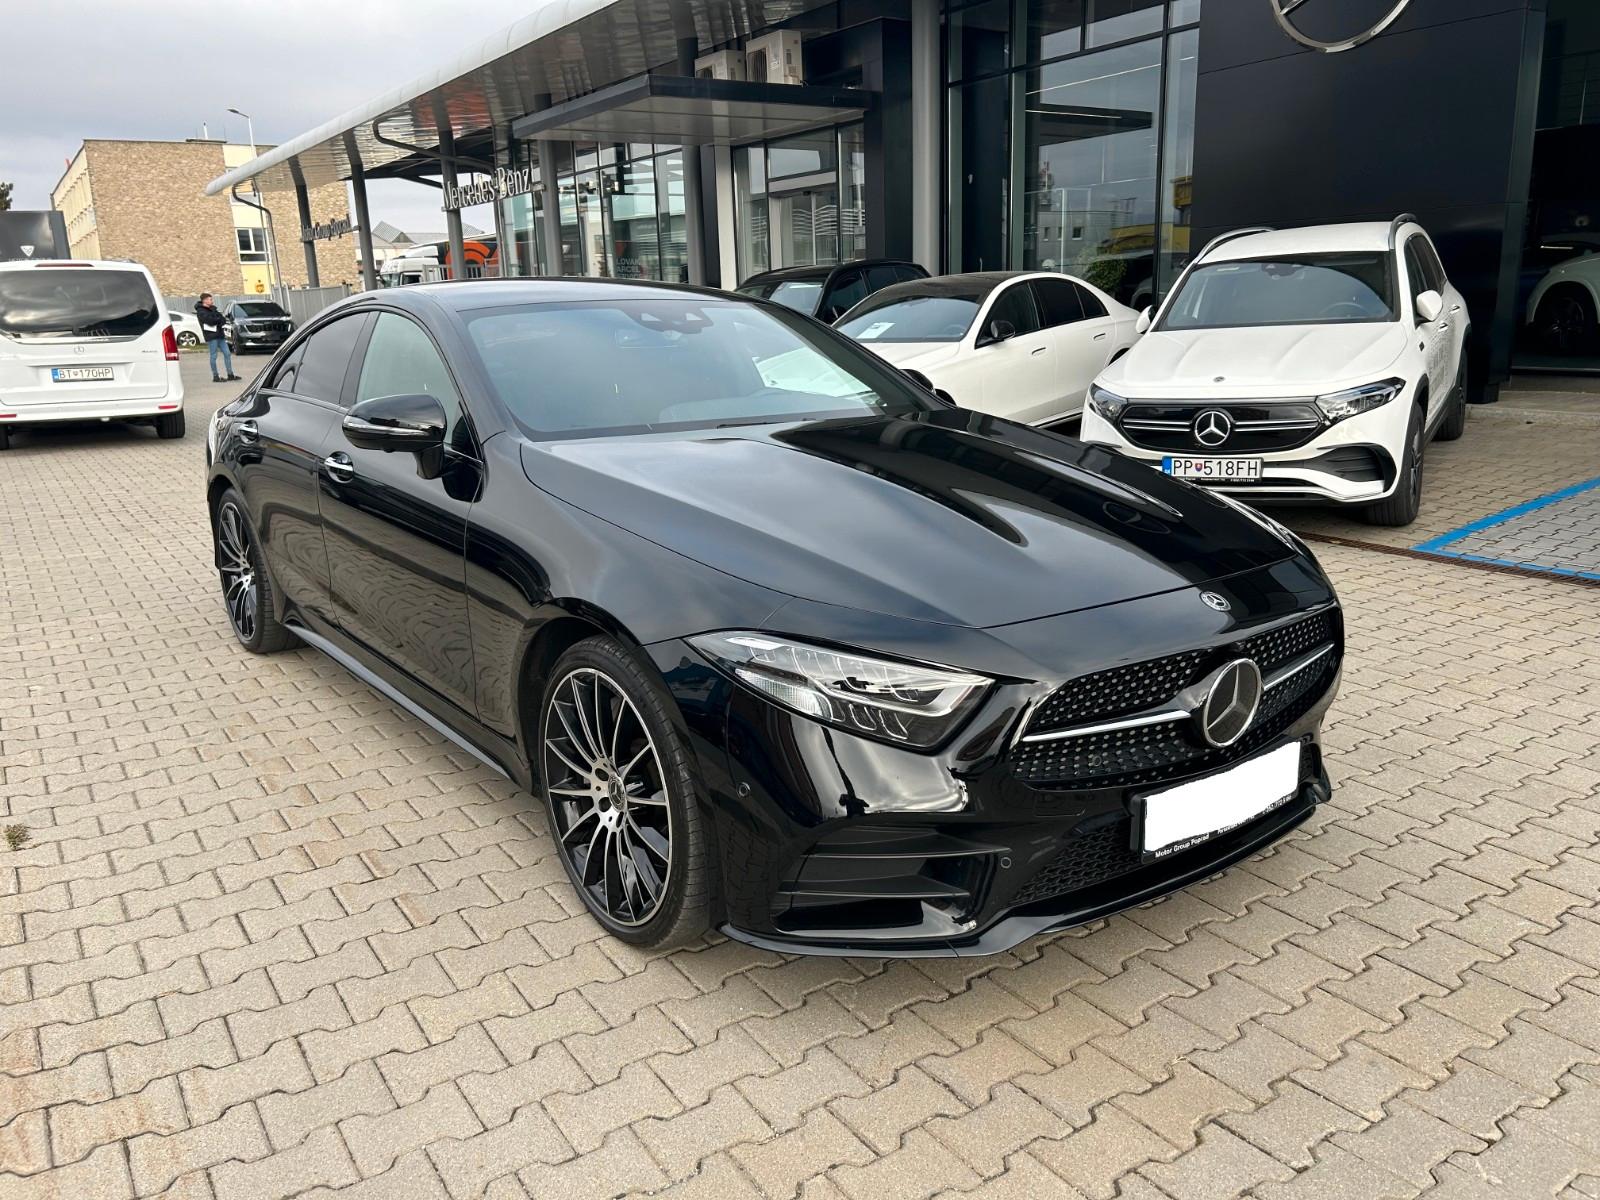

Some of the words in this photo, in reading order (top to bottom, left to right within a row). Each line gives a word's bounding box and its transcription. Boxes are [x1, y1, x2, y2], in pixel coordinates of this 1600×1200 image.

[442, 167, 531, 209] Mercedes-Benz
[1155, 847, 1172, 858] Motor
[1173, 842, 1191, 852] Group
[1191, 832, 1210, 845] Poprad
